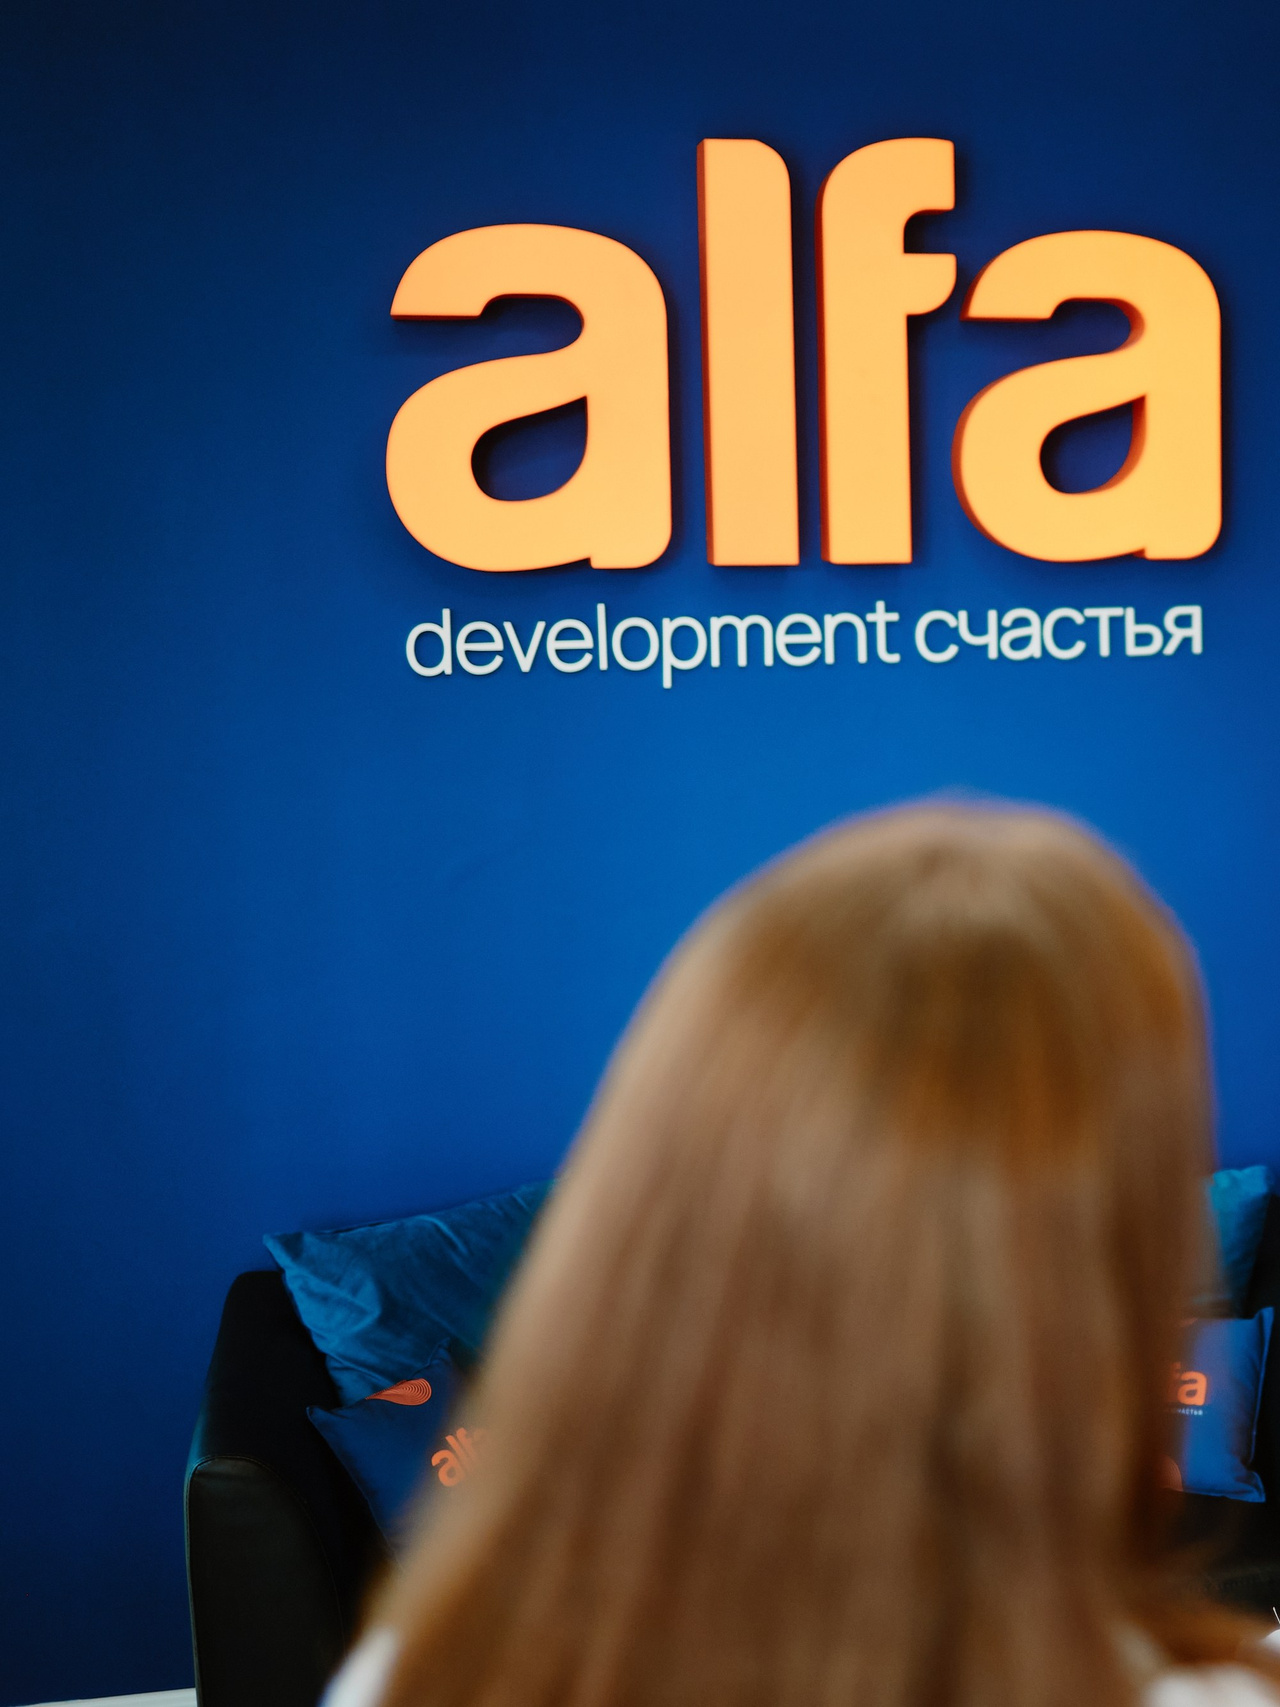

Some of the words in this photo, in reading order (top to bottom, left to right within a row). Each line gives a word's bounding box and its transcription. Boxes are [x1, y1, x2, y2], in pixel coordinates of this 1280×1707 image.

[386, 137, 1223, 572] alfa
[405, 601, 900, 689] development
[914, 605, 1203, 664] счастья
[431, 1427, 480, 1487] alf
